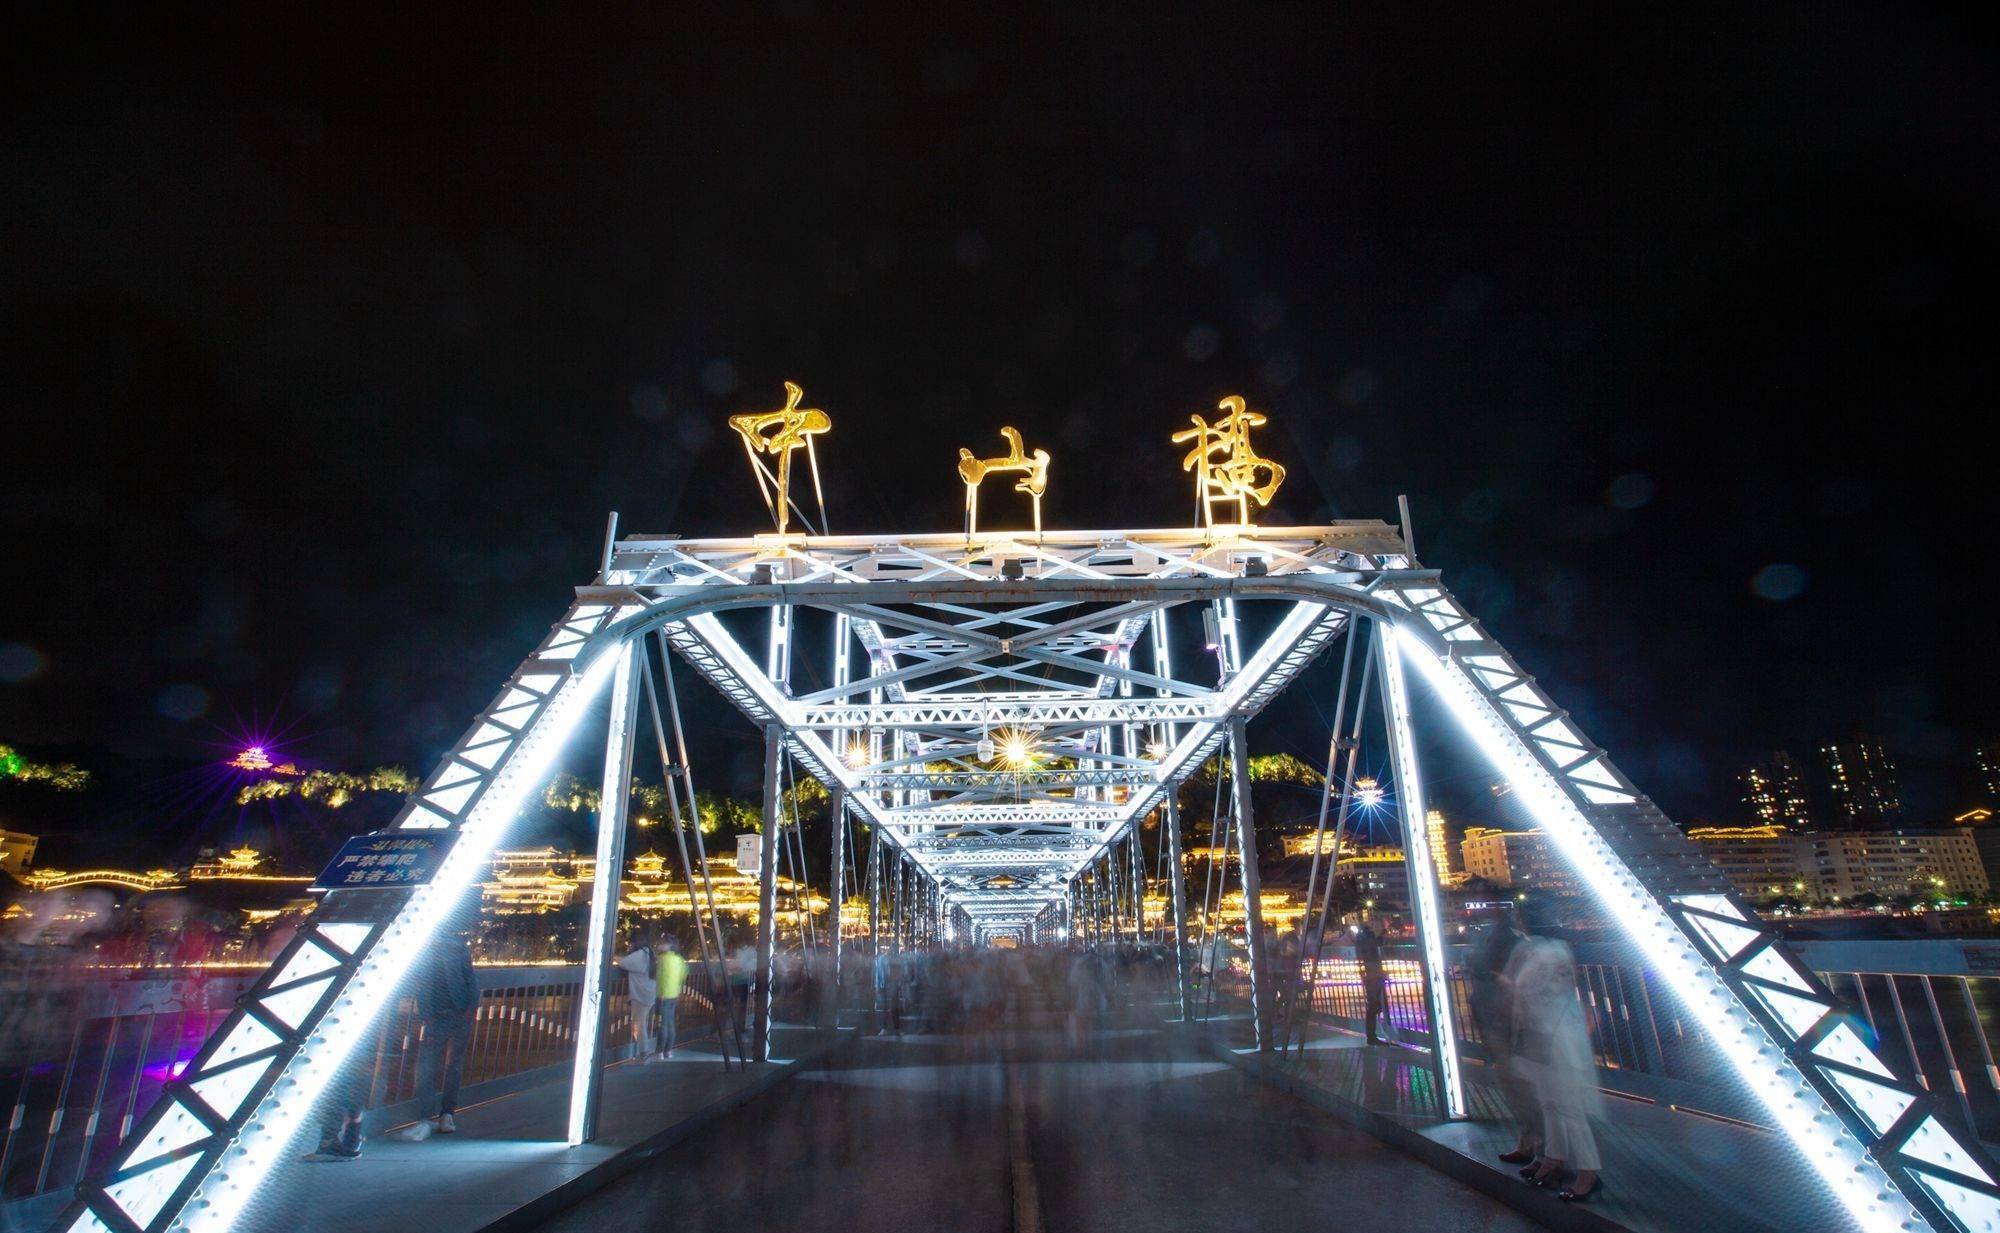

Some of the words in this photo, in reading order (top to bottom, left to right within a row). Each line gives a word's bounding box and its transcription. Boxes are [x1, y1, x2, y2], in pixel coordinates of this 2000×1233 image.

[337, 854, 417, 868] 严禁攀爬
[344, 869, 424, 883] 违者必究
